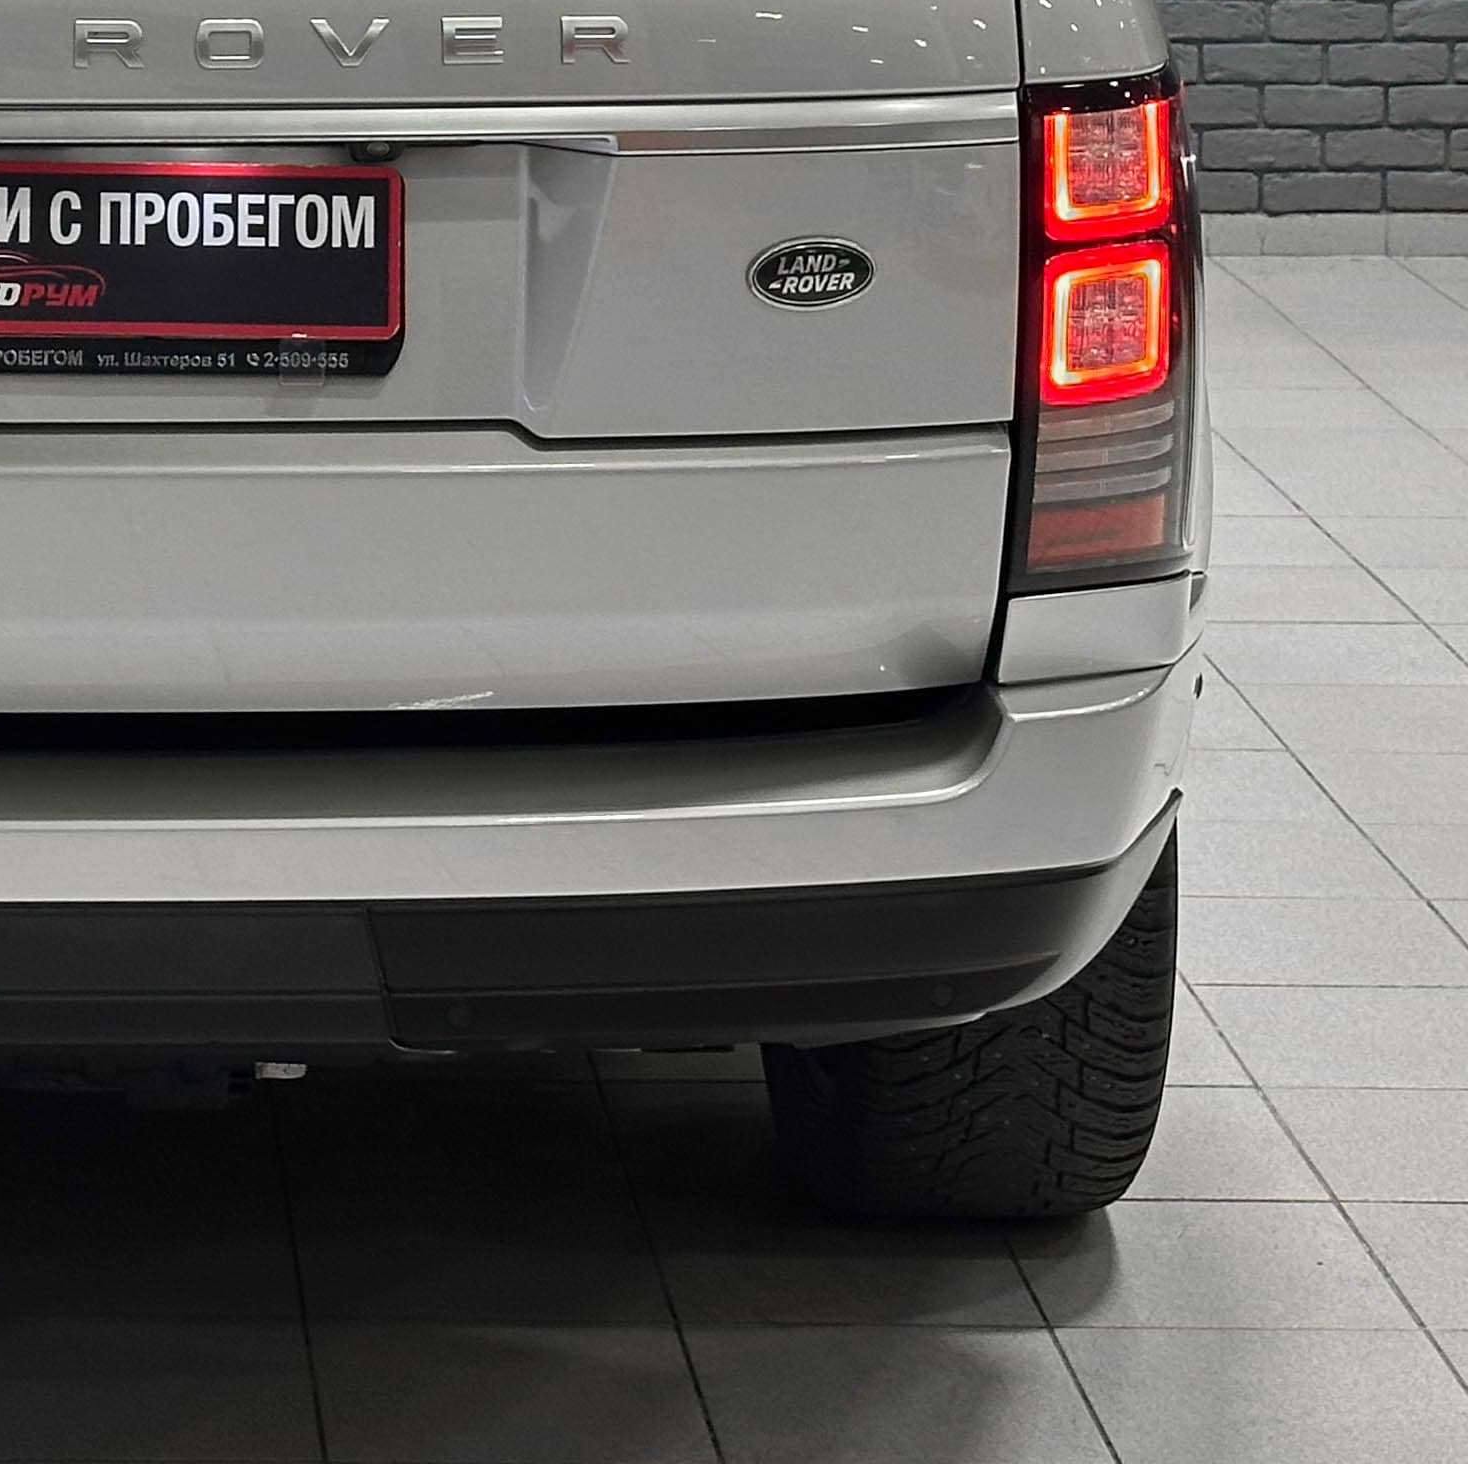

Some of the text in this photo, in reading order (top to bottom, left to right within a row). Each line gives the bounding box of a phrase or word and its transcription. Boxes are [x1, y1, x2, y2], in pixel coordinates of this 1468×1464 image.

[73, 15, 631, 67] ROVER
[49, 189, 81, 245] С
[99, 191, 376, 250] ПРОБЕГОМ
[777, 253, 836, 276] LAND
[782, 272, 855, 295] ROVER
[96, 354, 120, 370] ул.
[123, 352, 213, 370] Шахтеров
[216, 353, 236, 368] 51
